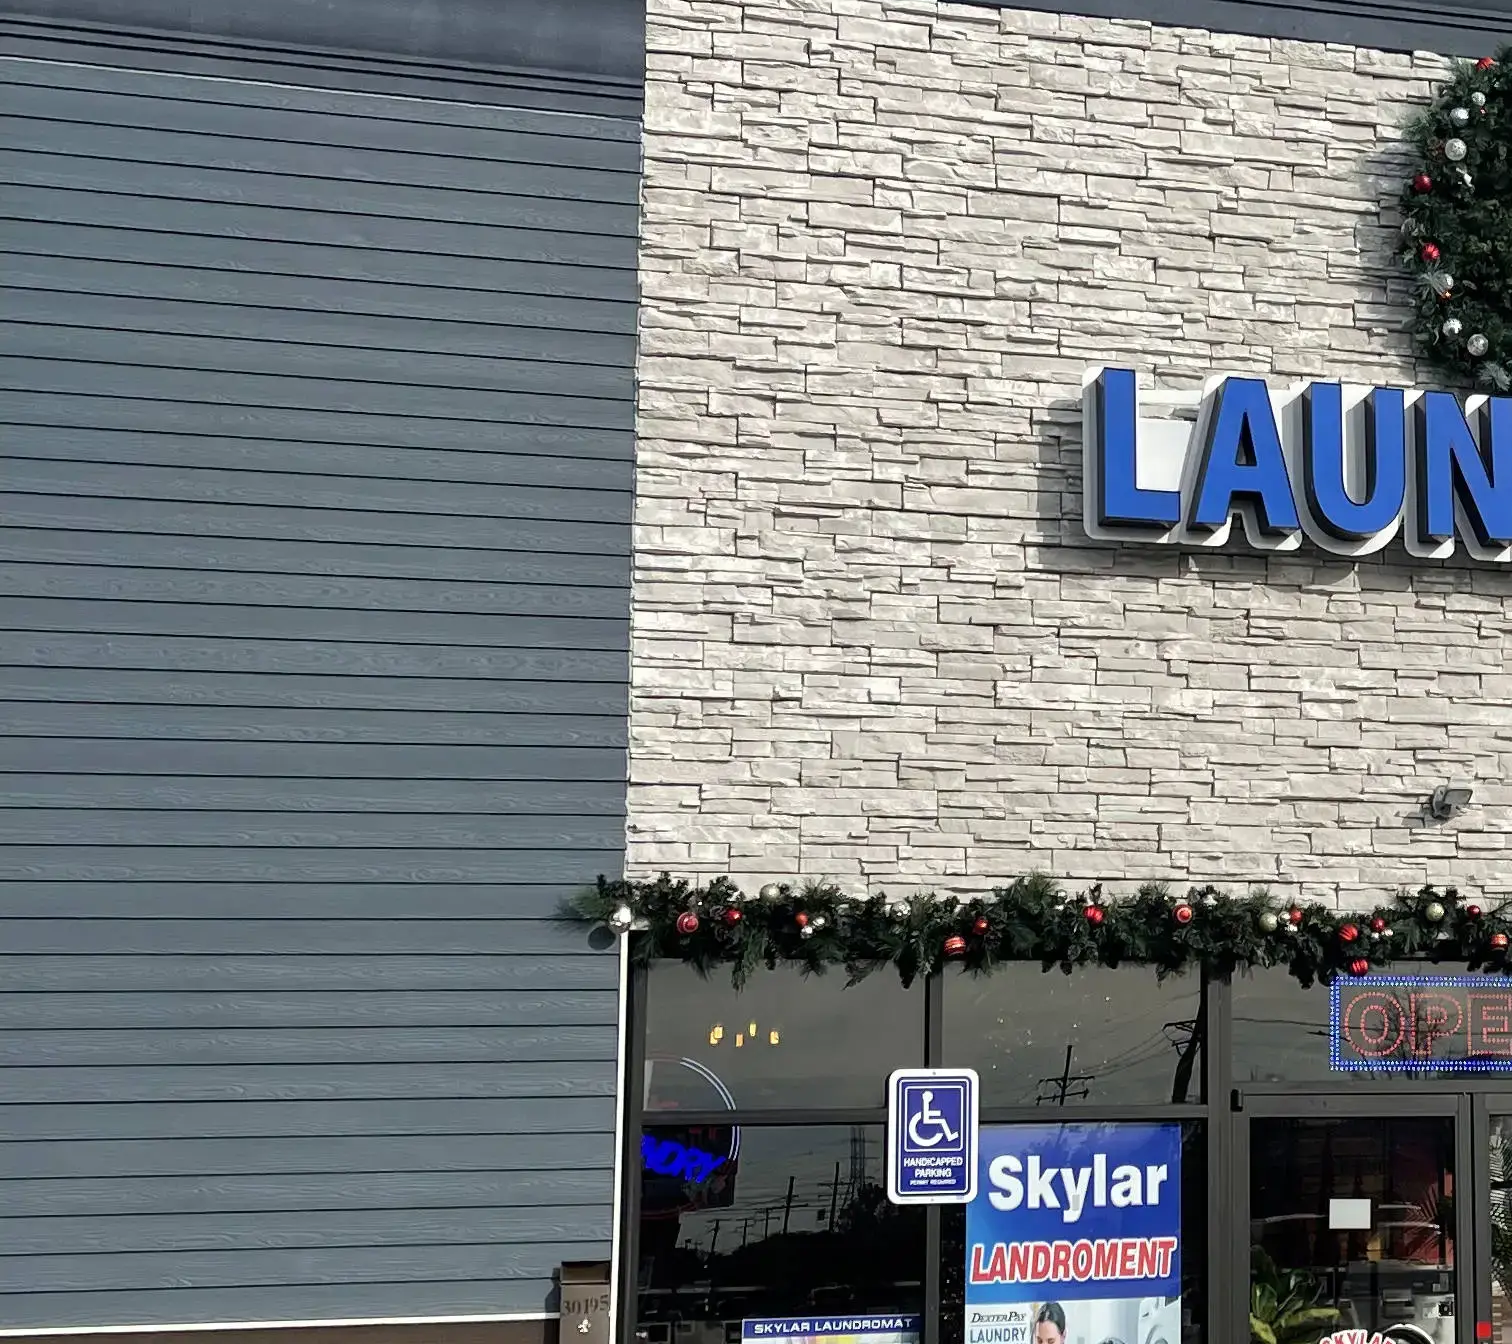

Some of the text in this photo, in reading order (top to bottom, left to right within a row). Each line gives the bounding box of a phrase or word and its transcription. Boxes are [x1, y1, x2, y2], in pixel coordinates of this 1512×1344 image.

[903, 1156, 964, 1168] HANDICAPPED
[914, 1167, 953, 1178] PARKING
[988, 1153, 1168, 1223] Skylar
[970, 1237, 1178, 1285] LANDROMENT
[754, 1318, 913, 1334] SKYLAR LAUNDROMAT
[970, 1327, 1027, 1344] LAUNDRY
